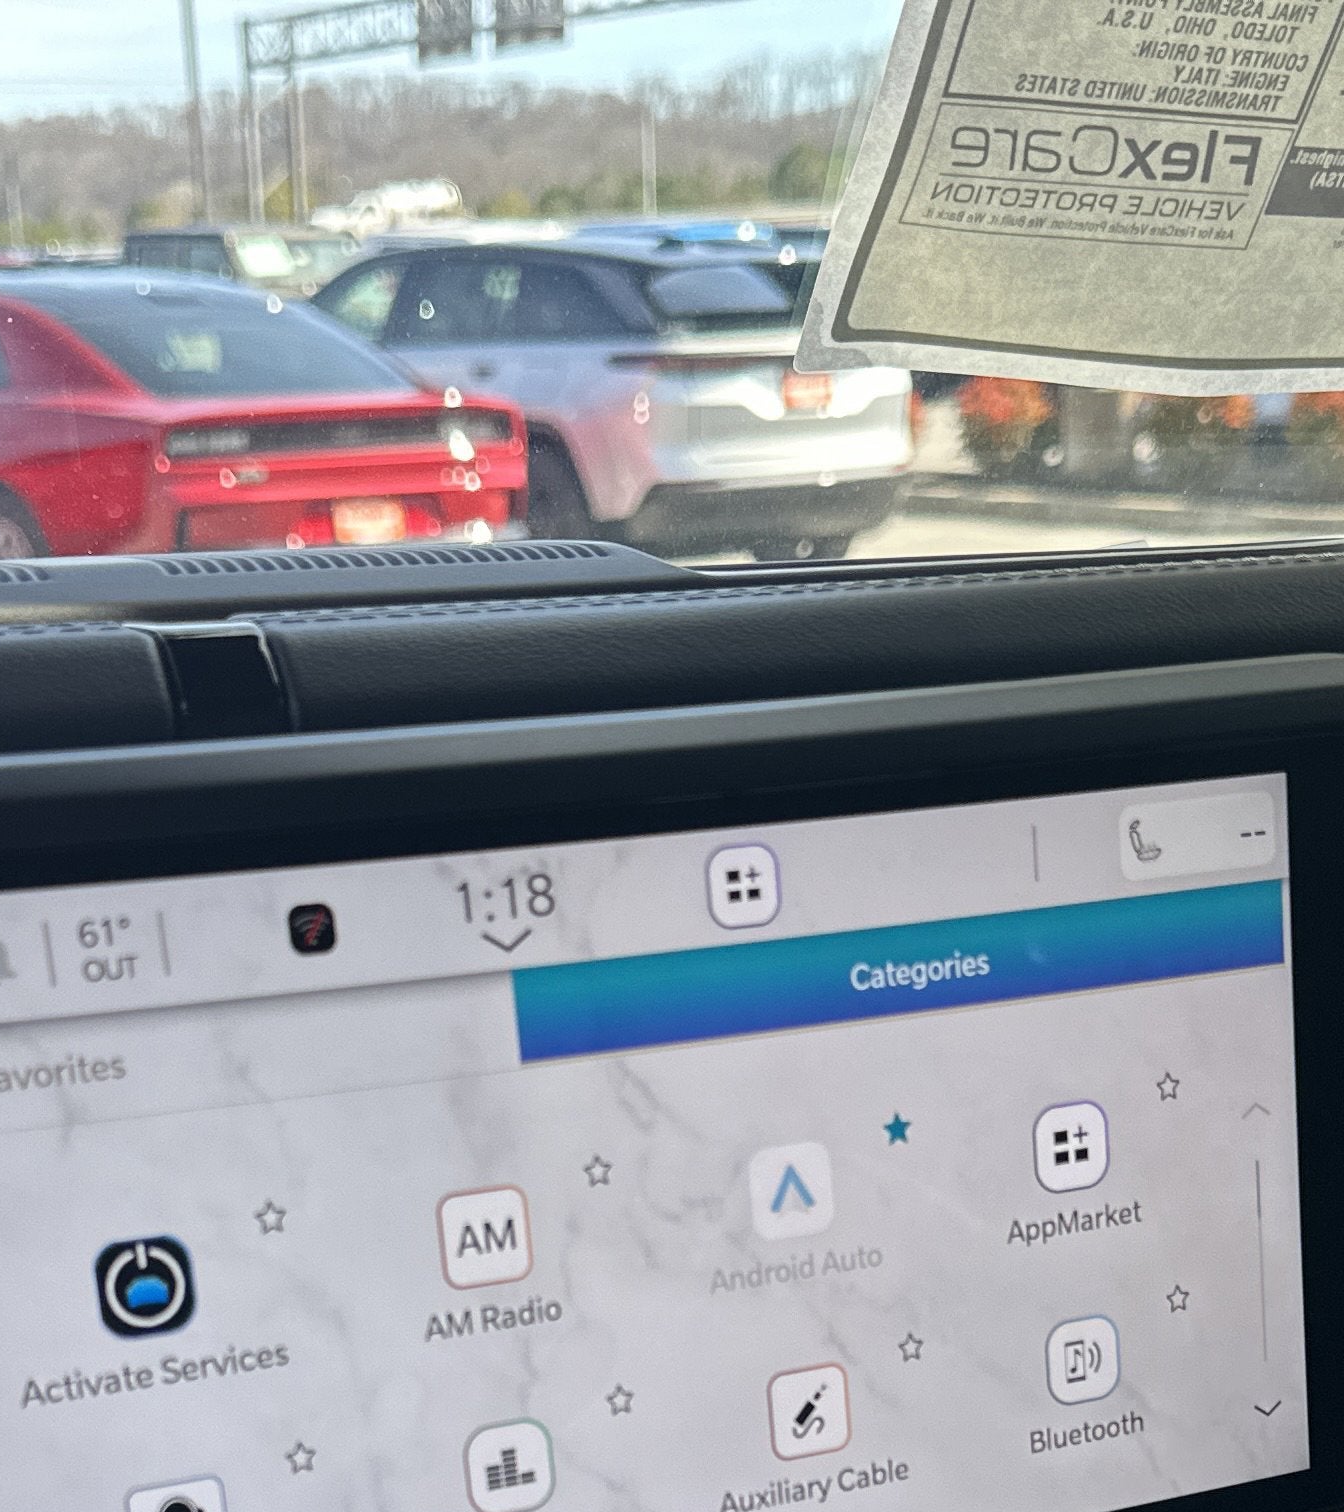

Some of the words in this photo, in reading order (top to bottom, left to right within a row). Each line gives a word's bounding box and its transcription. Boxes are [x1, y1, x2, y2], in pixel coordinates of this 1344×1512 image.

[455, 872, 556, 927] 1:18
[77, 917, 131, 951] 61°
[81, 955, 139, 985] OUT
[849, 949, 991, 993] Categories
[456, 1216, 518, 1261] AM
[1006, 1200, 1143, 1247] AppMarket
[708, 1256, 815, 1296] Android
[821, 1244, 883, 1276] Auto
[423, 1311, 475, 1343] AM
[480, 1296, 562, 1332] Radio
[19, 1361, 154, 1409] Activate
[160, 1342, 291, 1386] Services
[1029, 1411, 1144, 1455] Bluetooth
[837, 1459, 910, 1493] Cable
